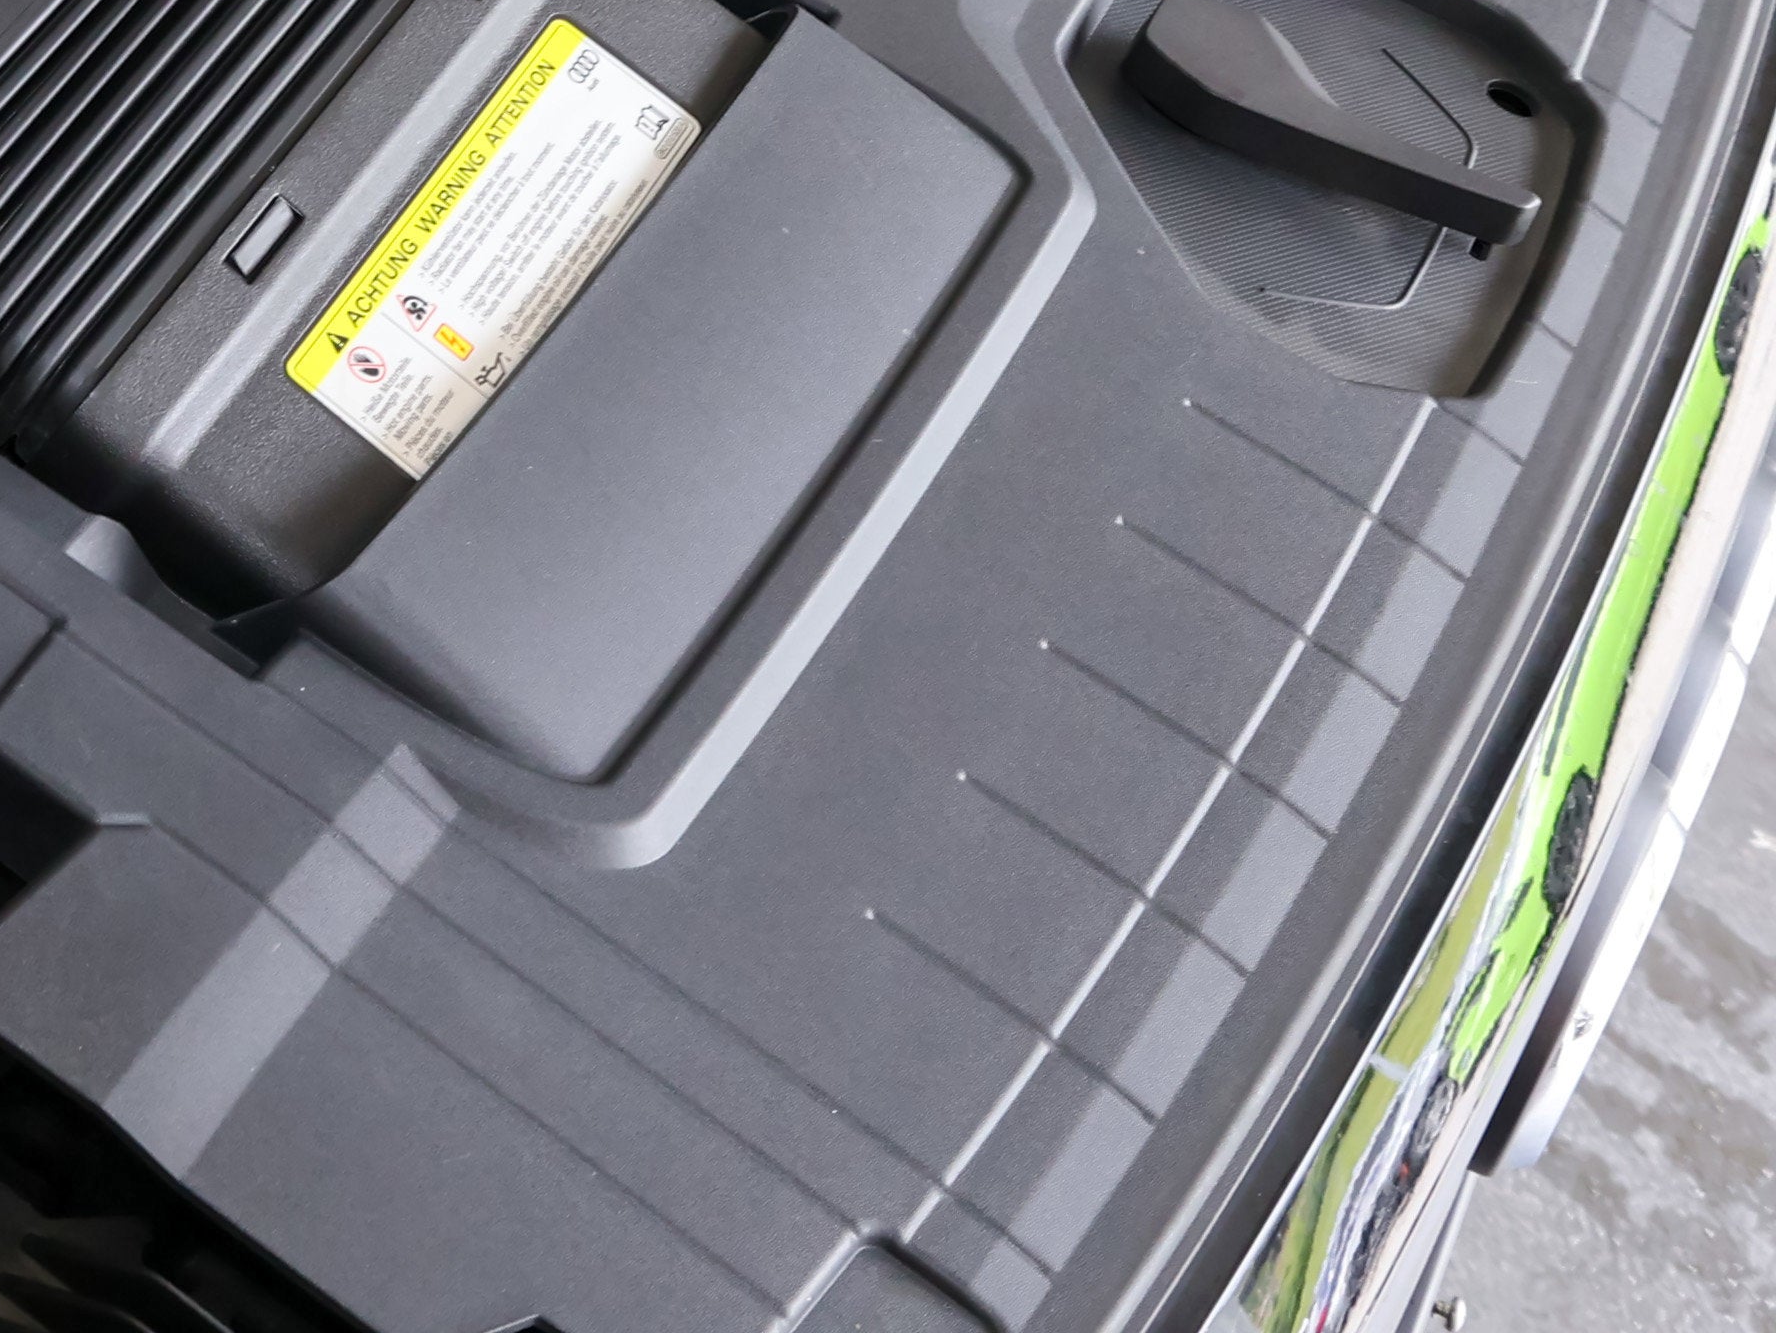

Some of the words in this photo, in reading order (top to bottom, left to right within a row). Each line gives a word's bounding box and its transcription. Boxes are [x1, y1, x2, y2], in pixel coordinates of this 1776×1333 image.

[342, 235, 420, 328] ACHTUNG
[413, 147, 488, 236] WARNING
[480, 57, 558, 148] ATTENTION
